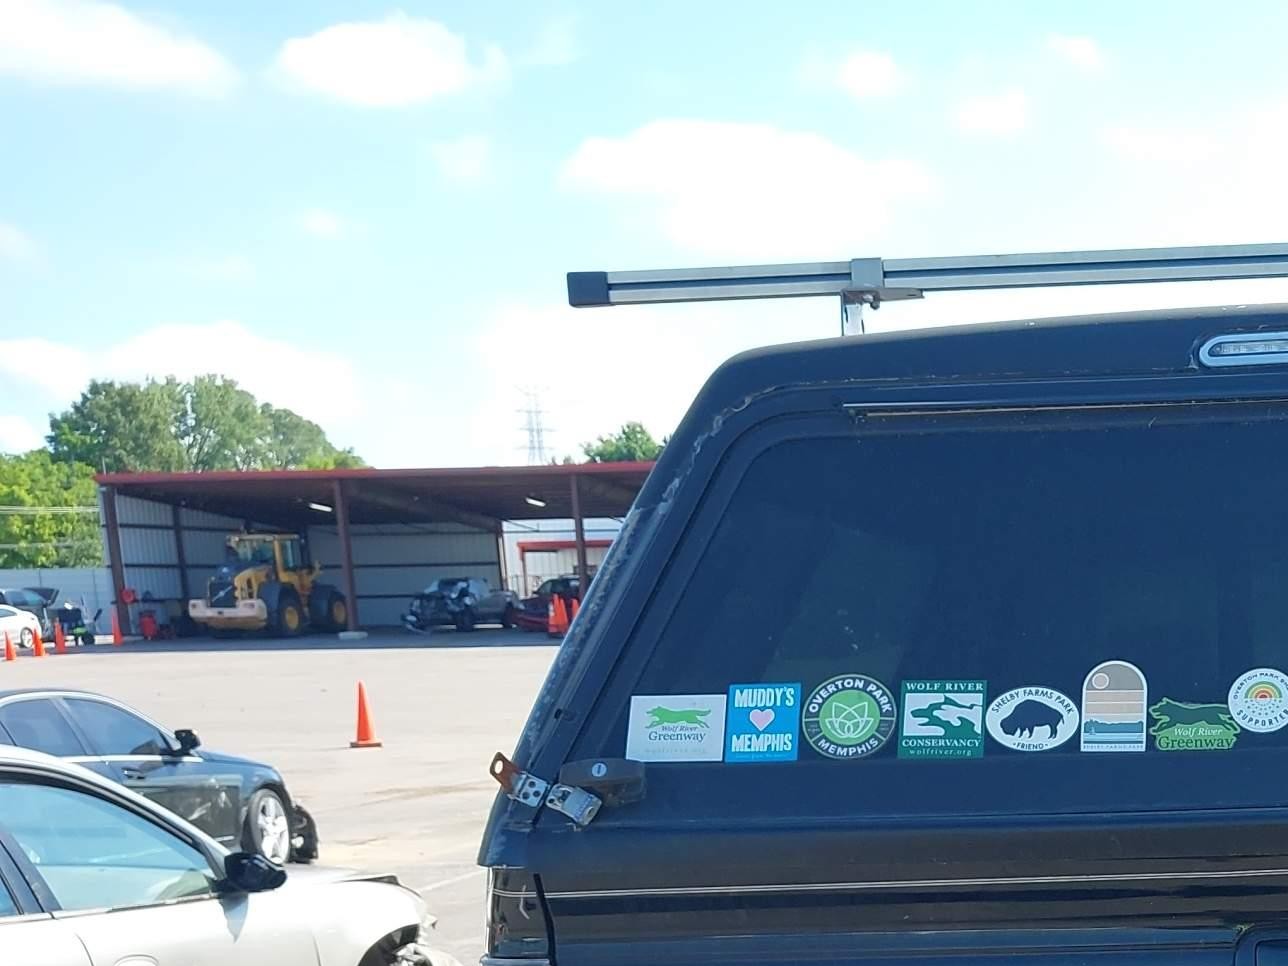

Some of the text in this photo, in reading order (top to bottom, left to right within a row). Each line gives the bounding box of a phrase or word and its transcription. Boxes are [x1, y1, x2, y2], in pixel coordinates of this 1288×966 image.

[906, 682, 984, 691] WOLF RIVER
[734, 687, 795, 708] MUDDY'S
[808, 678, 893, 713] OVERTON PARK
[991, 688, 1074, 714] SHELBY FARMS PARK
[648, 732, 707, 743] Greenway
[1174, 728, 1223, 737] Wolf River
[731, 733, 793, 752] MEMPHIS
[817, 737, 879, 757] MEMPHIS
[902, 738, 982, 748] CONSERVANCY
[1016, 743, 1045, 751] FRIEND
[1158, 736, 1234, 749] Greenway
